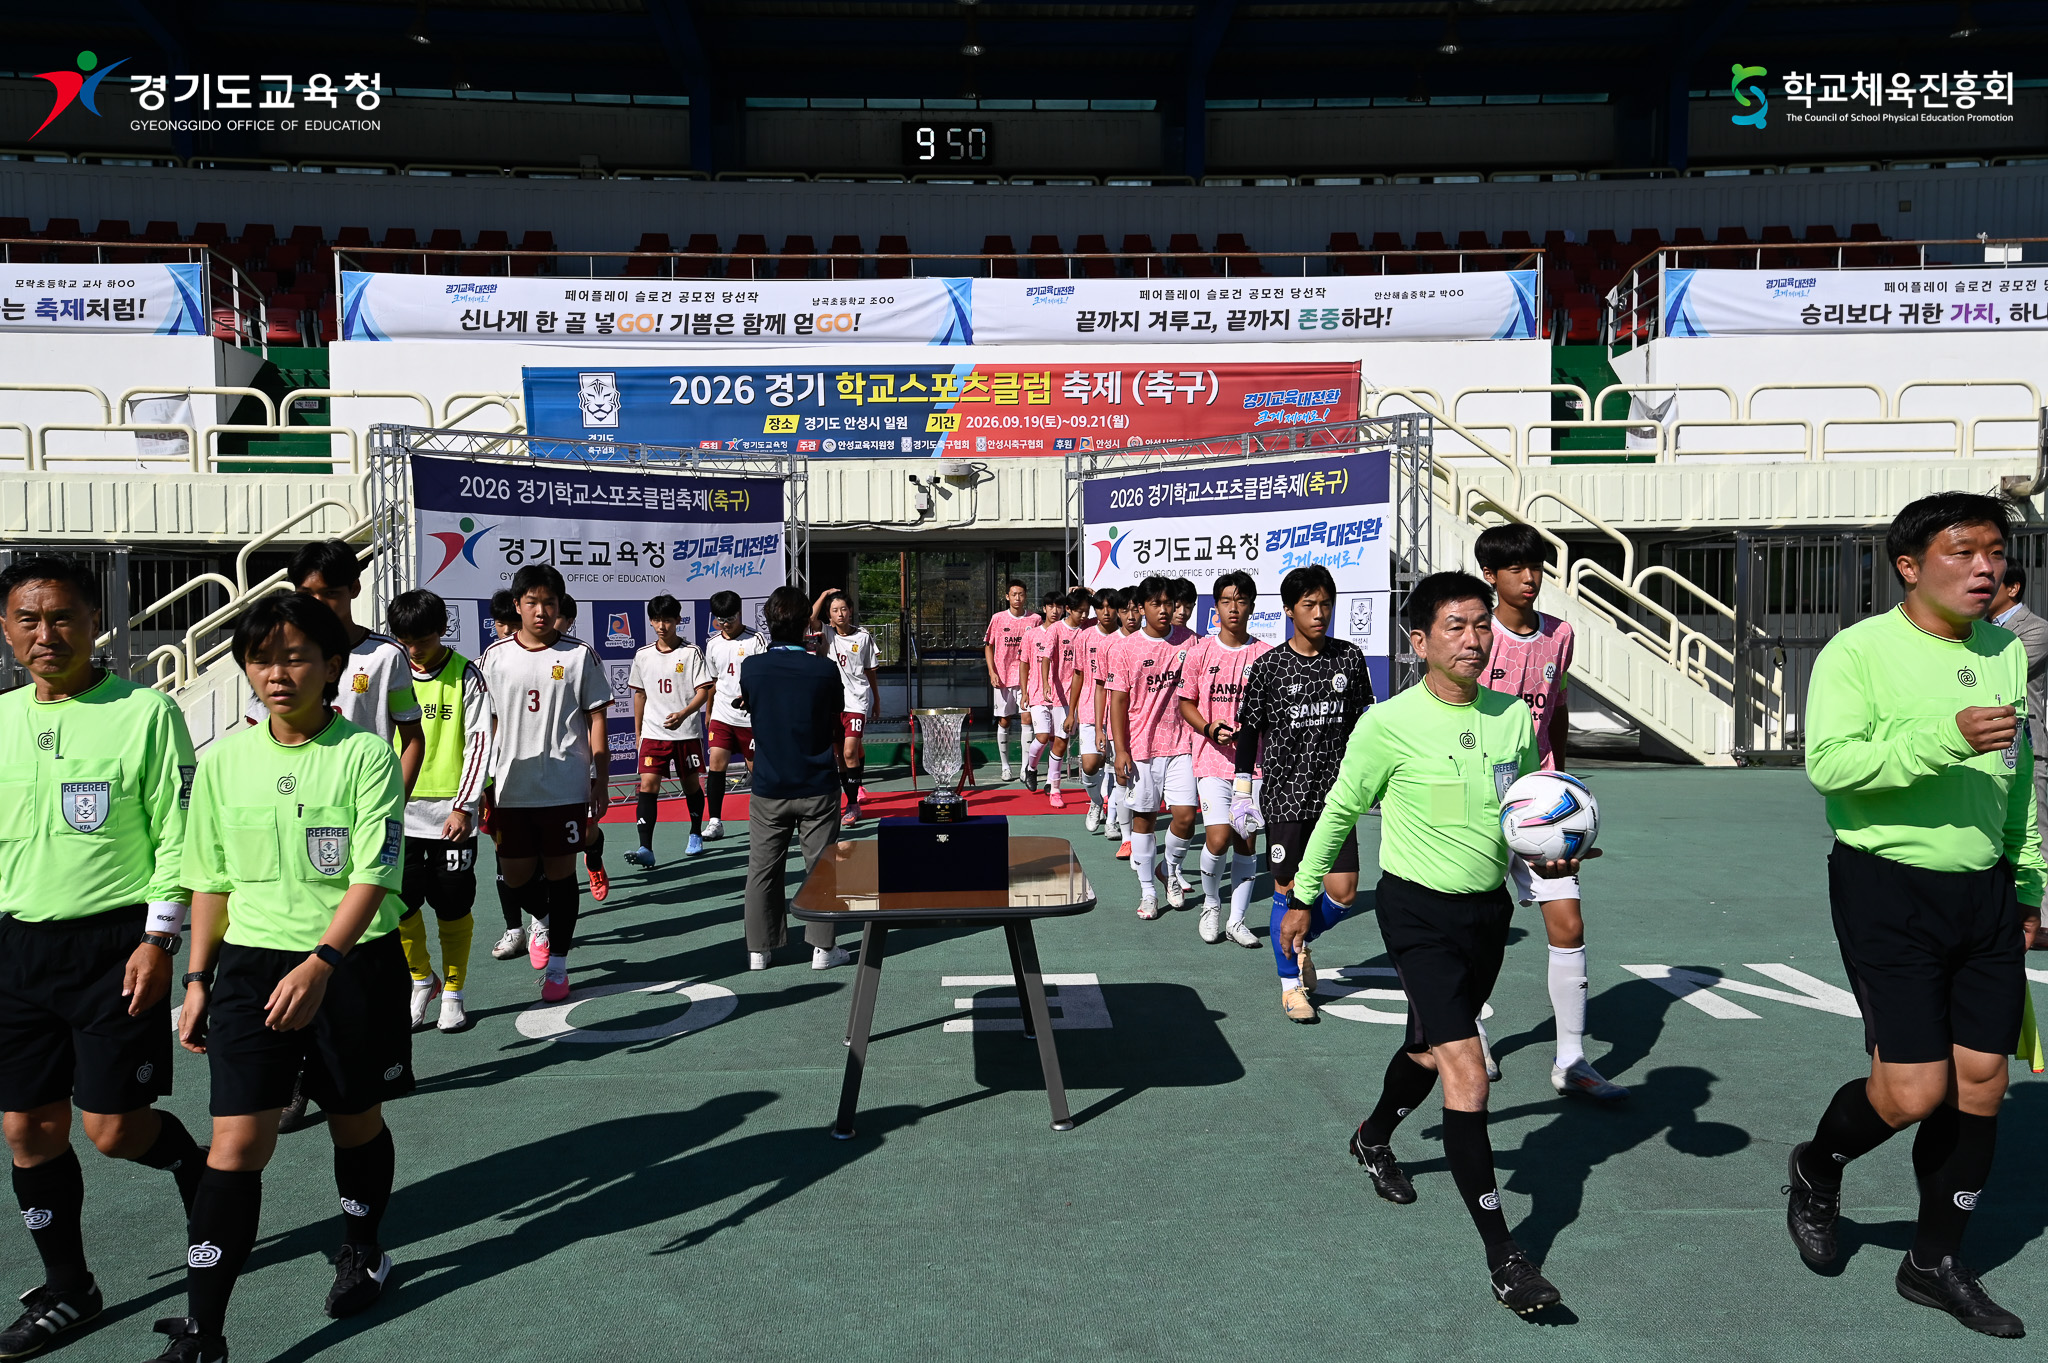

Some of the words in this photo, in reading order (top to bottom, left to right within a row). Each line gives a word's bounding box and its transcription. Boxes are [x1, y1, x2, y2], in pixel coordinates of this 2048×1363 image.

[916, 127, 935, 160] 9
[945, 128, 986, 160] 50
[82, 280, 102, 288] 교사
[1884, 281, 1947, 293] 페어플레이
[1954, 281, 1992, 292] 슬로건
[1999, 280, 2037, 292] 공모전
[565, 290, 628, 302] 페어플레이
[635, 291, 672, 302] 슬로건
[678, 292, 715, 303] 공모전
[722, 292, 759, 303] 당선작
[1140, 289, 1200, 300] 페어플레이
[1207, 289, 1242, 300] 슬로건
[1249, 288, 1284, 300] 공모전
[1290, 288, 1326, 299] 당선작
[0, 298, 26, 321] 는
[35, 298, 146, 322] 축제처럼!
[1800, 303, 1892, 325] 승리보다
[1899, 302, 1944, 324] 귀한
[1950, 302, 2000, 325] 가치,
[460, 309, 528, 332] 신나게
[536, 310, 558, 332] 한
[565, 312, 586, 334] 골
[595, 312, 664, 334] 넣GO!
[670, 313, 735, 335] 기쁨은
[743, 313, 786, 335] 함께
[794, 313, 861, 335] 얻GO!
[1076, 310, 1139, 332] 끝까지
[1148, 310, 1217, 333] 겨루고,
[1227, 309, 1289, 331] 끝까지
[1298, 307, 1392, 330] 존중하라!
[669, 374, 756, 406] 2026
[765, 373, 826, 408] 경기
[836, 371, 1052, 407] 학교스포츠클럽
[1061, 370, 1122, 406] 축제
[1132, 369, 1220, 406] (축구)
[1243, 390, 1300, 410] 경기교육
[1298, 389, 1341, 408] 대전환
[768, 418, 793, 430] 장소
[804, 416, 841, 430] 경기도
[844, 416, 880, 430] 안성시
[884, 416, 908, 430] 일원
[931, 416, 956, 430] 기간
[966, 415, 1130, 429] 2026.09.19(토)~09.21(월)
[1254, 410, 1284, 426] 크게
[742, 440, 788, 449] 경기도교육청
[800, 441, 816, 450] 주관
[838, 440, 895, 450] 안성교육지원청
[913, 440, 970, 450] 경기도축구협회
[987, 440, 1044, 449] 안성시축구협회
[1056, 439, 1072, 449] 후원
[1096, 439, 1120, 449] 안성시
[459, 476, 511, 500] 2026
[516, 478, 750, 512] 경기학교스포츠클럽축제(축구)
[1110, 486, 1144, 509] 2026
[1148, 468, 1348, 508] 경기학교스포츠클럽축제(축구)
[1265, 520, 1328, 553] 경기교육
[1327, 517, 1383, 547] 대전환
[500, 538, 666, 569] 경기도교육청
[672, 535, 734, 561] 경기교육
[734, 534, 780, 560] 대전환
[1133, 532, 1259, 564] 경기도교육청
[686, 562, 719, 582] 크게
[720, 559, 766, 579] 제대로!
[1278, 552, 1312, 574] 크게
[567, 574, 598, 582] OFFICE
[603, 574, 614, 582] OF
[618, 574, 665, 583] EDUCATION
[1134, 570, 1176, 578] GYEONGGIDO
[1179, 569, 1202, 577] OFFICE
[1205, 568, 1214, 576] OF
[727, 663, 735, 676] 4
[657, 678, 672, 694] 16
[528, 690, 540, 712] 3
[424, 703, 453, 720] 행동
[850, 718, 862, 732] 18
[686, 754, 700, 769] 16
[63, 783, 107, 793] REFEREE
[308, 829, 348, 838] REFEREE
[564, 820, 580, 844] 3
